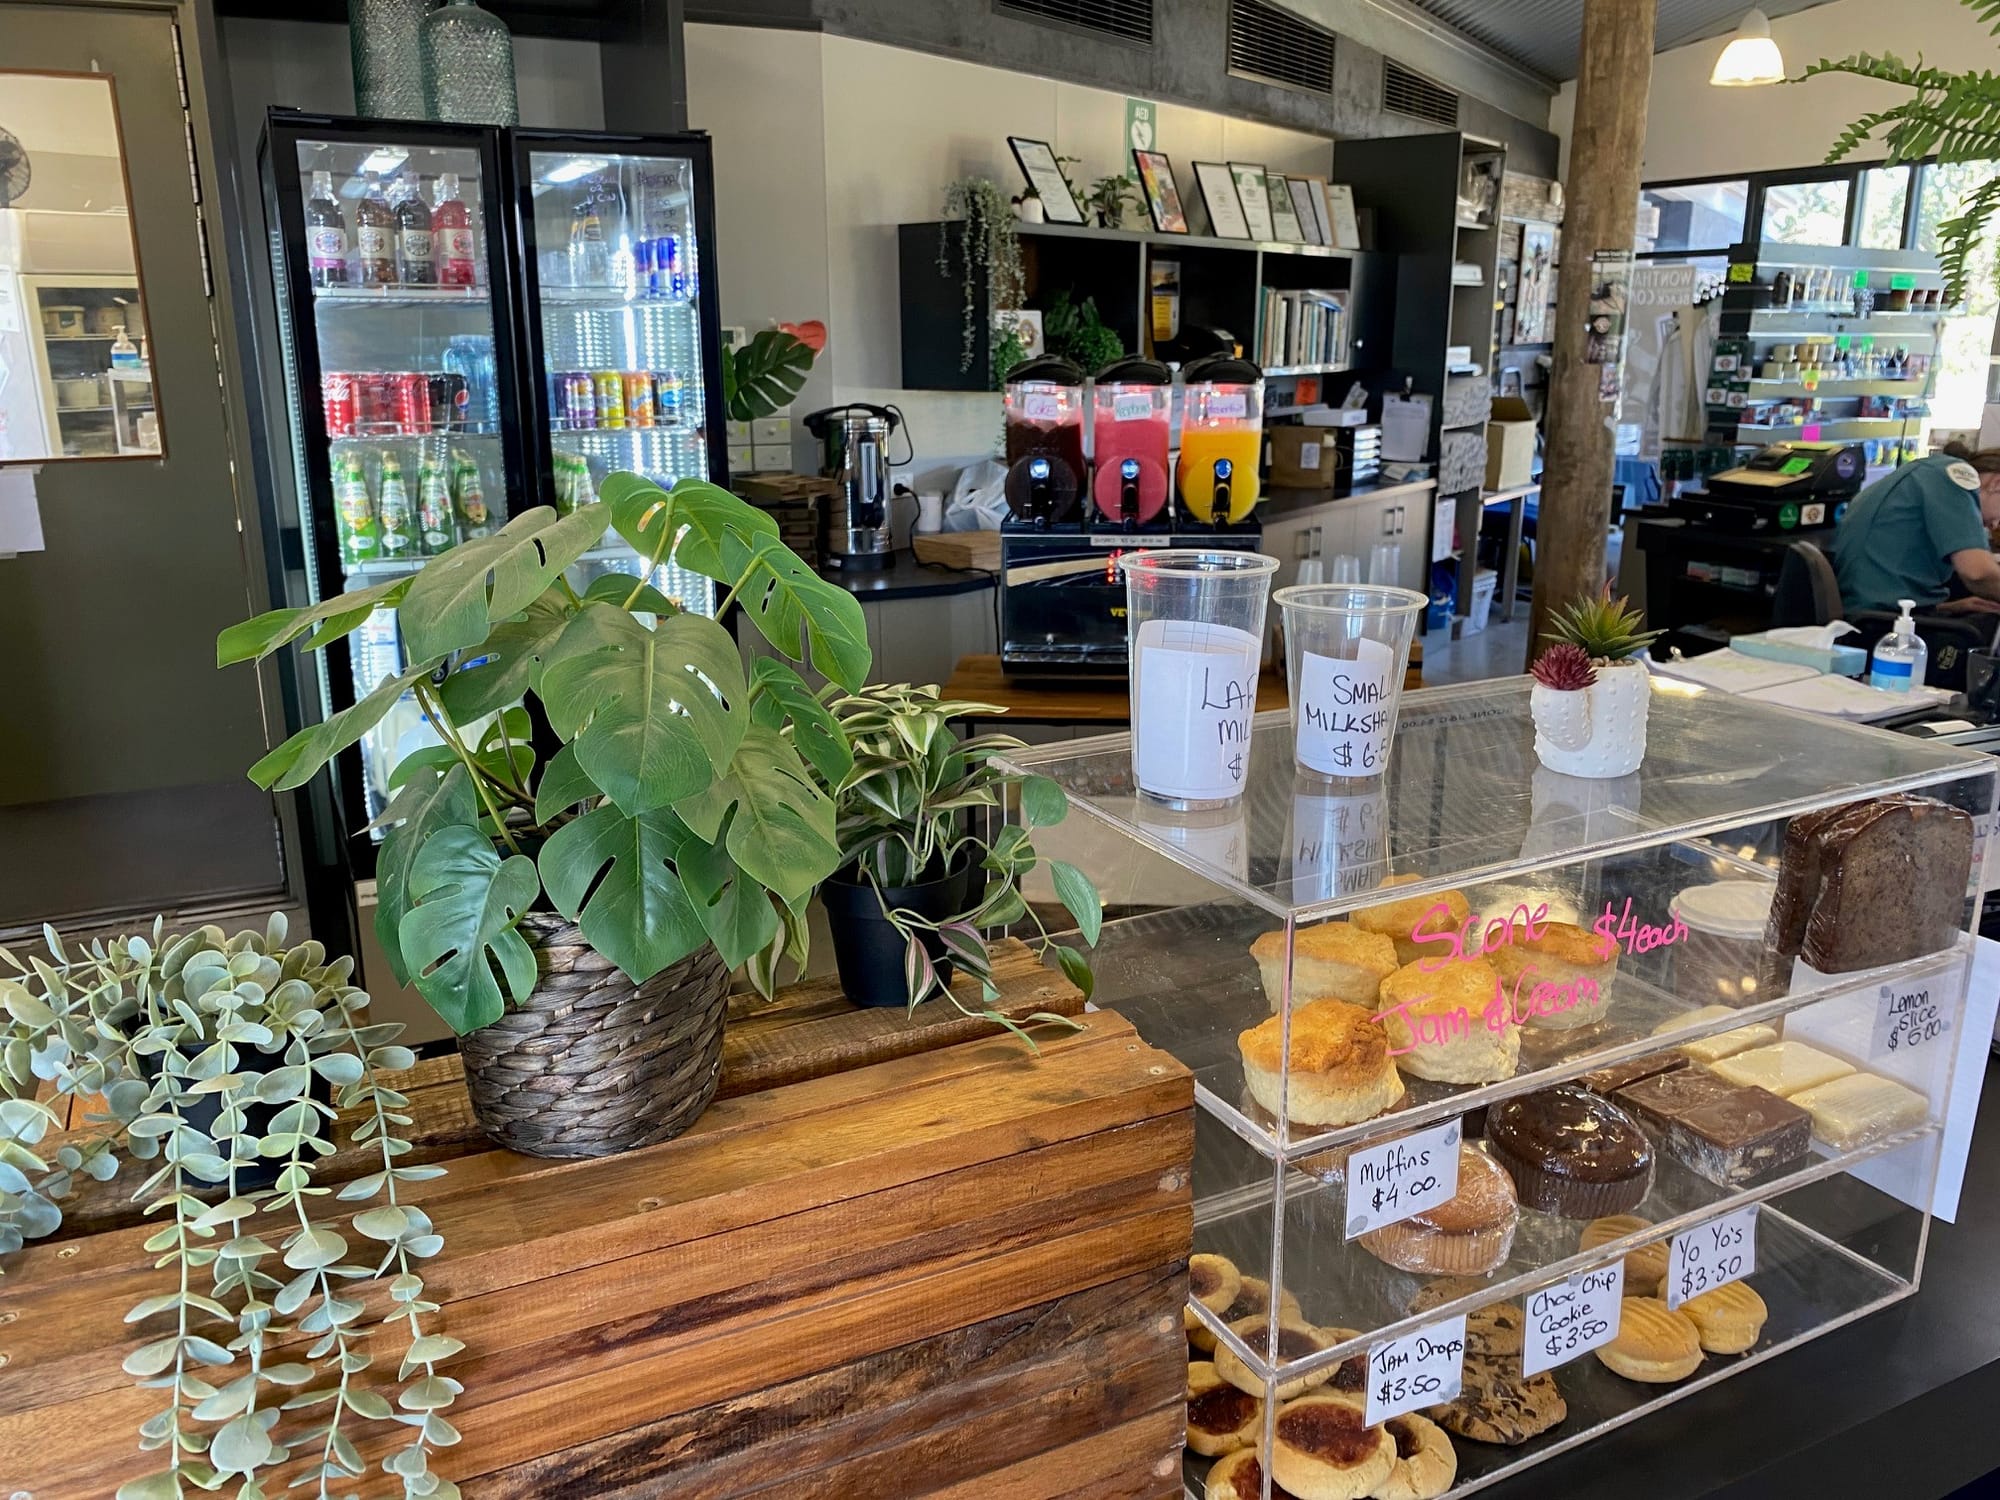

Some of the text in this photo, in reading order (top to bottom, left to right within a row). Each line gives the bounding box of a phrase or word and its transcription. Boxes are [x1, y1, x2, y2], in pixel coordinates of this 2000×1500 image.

[1135, 106, 1149, 120] AED
[1411, 902, 1550, 972] Scone
[1370, 994, 1470, 1056] Jam
[1511, 964, 1599, 1025] Cream
[1888, 990, 1929, 1017] Lemon
[1899, 1005, 1938, 1031] Slice
[1360, 1144, 1431, 1186] Muffins
[1679, 1223, 1743, 1269] Yo Yo's
[1532, 1271, 1617, 1318] Choc Chip
[1681, 1255, 1742, 1300] $3.50
[1540, 1303, 1594, 1334] Cookie
[1372, 1337, 1464, 1375] JAM Drops
[1545, 1319, 1608, 1357] $3.50
[1376, 1374, 1441, 1406] $3.50
